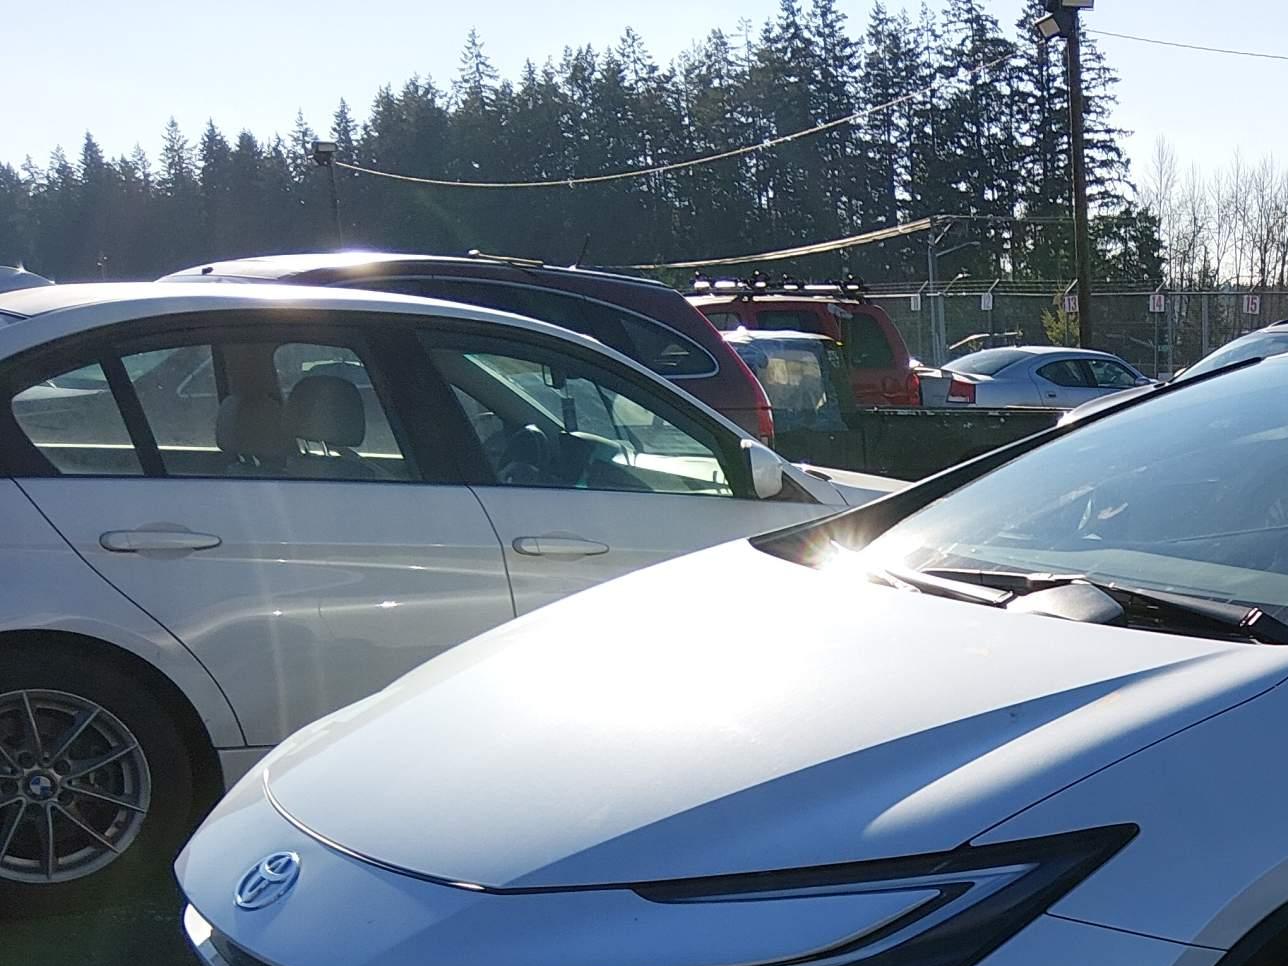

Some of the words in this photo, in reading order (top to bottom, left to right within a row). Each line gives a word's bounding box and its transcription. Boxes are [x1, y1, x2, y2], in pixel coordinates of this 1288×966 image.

[1066, 296, 1077, 311] 13
[1151, 296, 1162, 311] 14
[1246, 296, 1258, 312] 15
